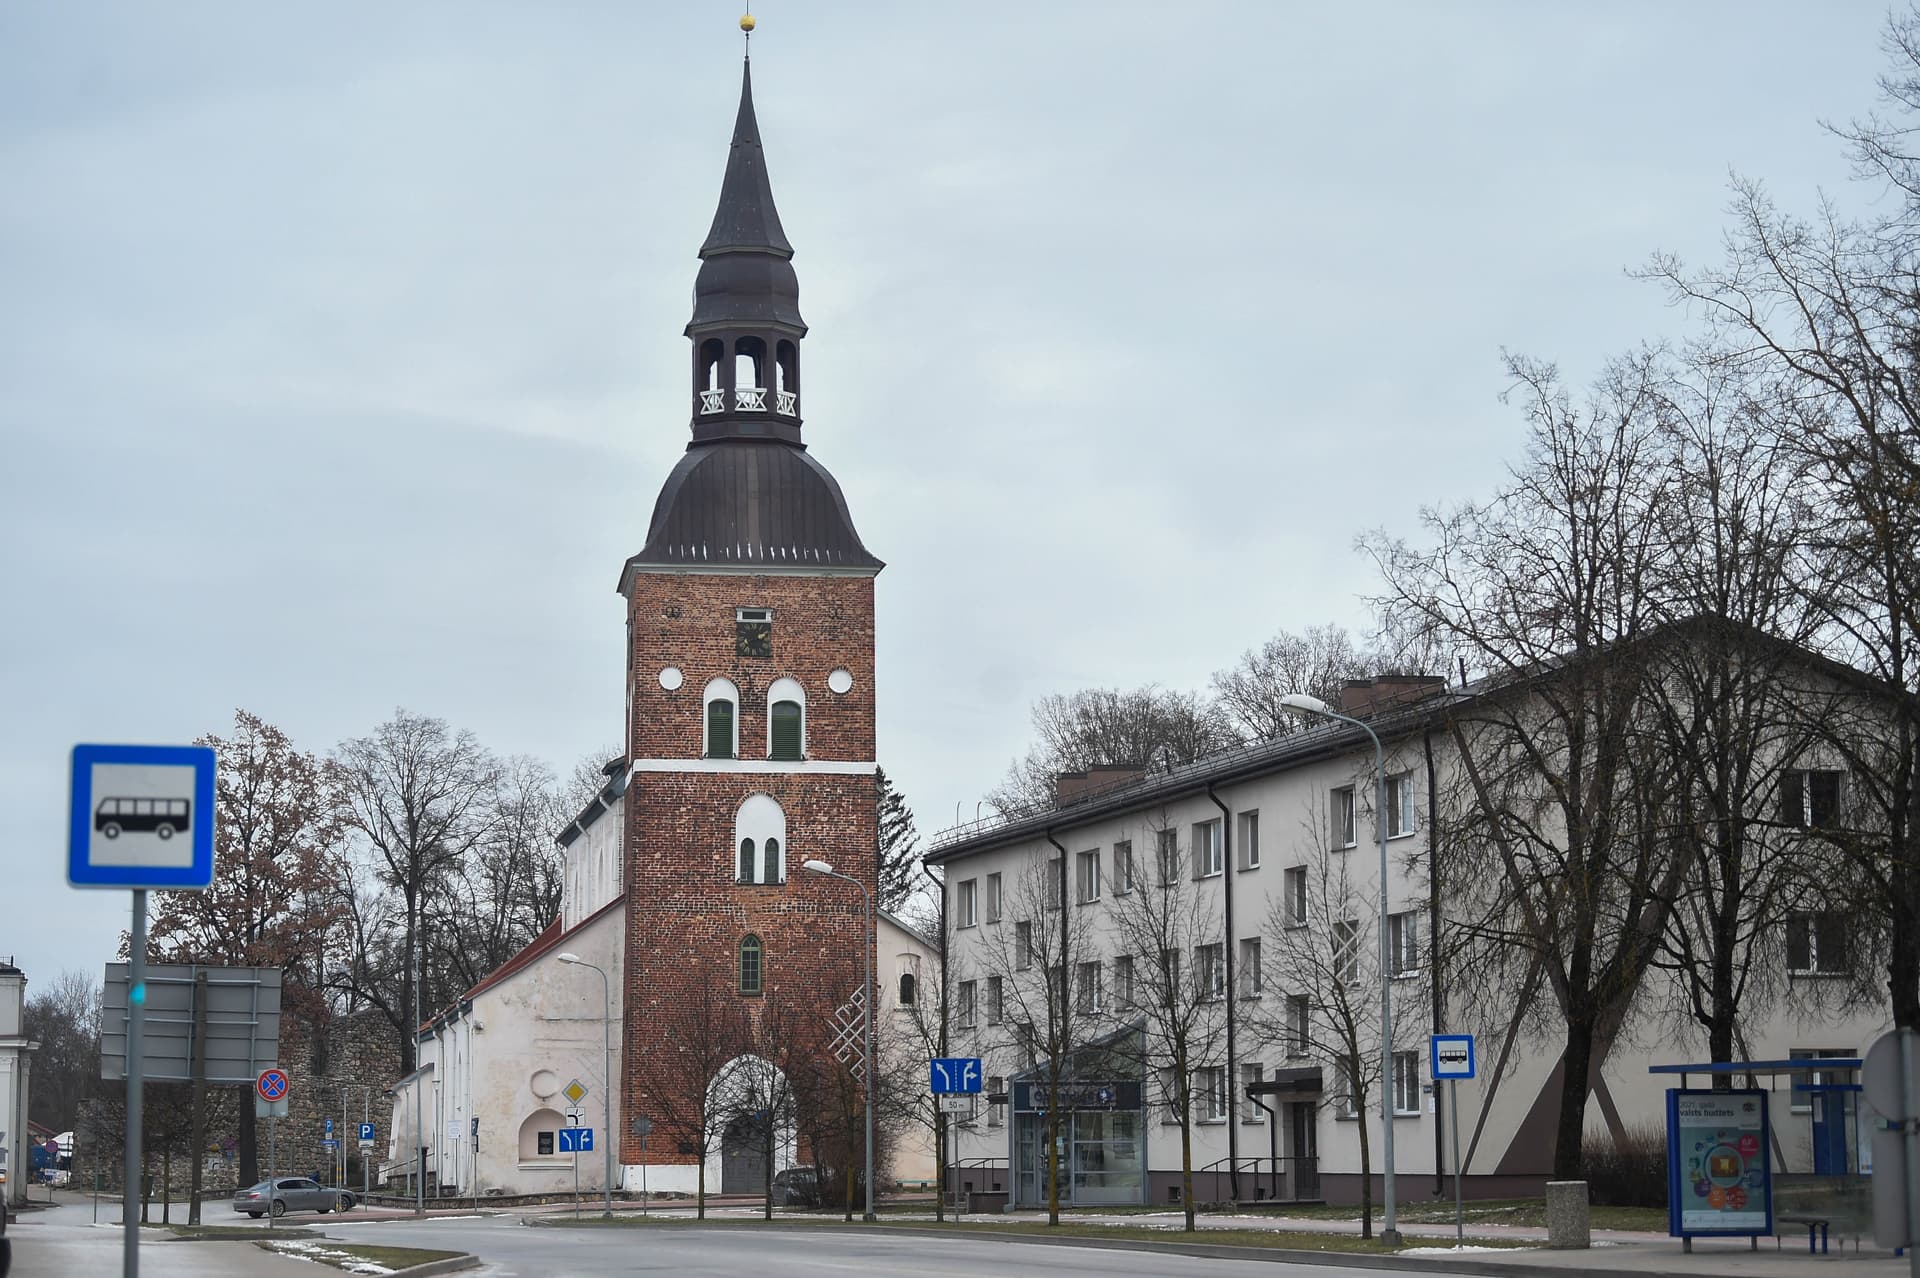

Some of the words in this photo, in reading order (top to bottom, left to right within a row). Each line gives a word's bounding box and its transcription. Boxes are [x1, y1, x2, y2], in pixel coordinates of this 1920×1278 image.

[948, 1101, 957, 1109] 50
[326, 1120, 331, 1131] P
[362, 1125, 371, 1138] P
